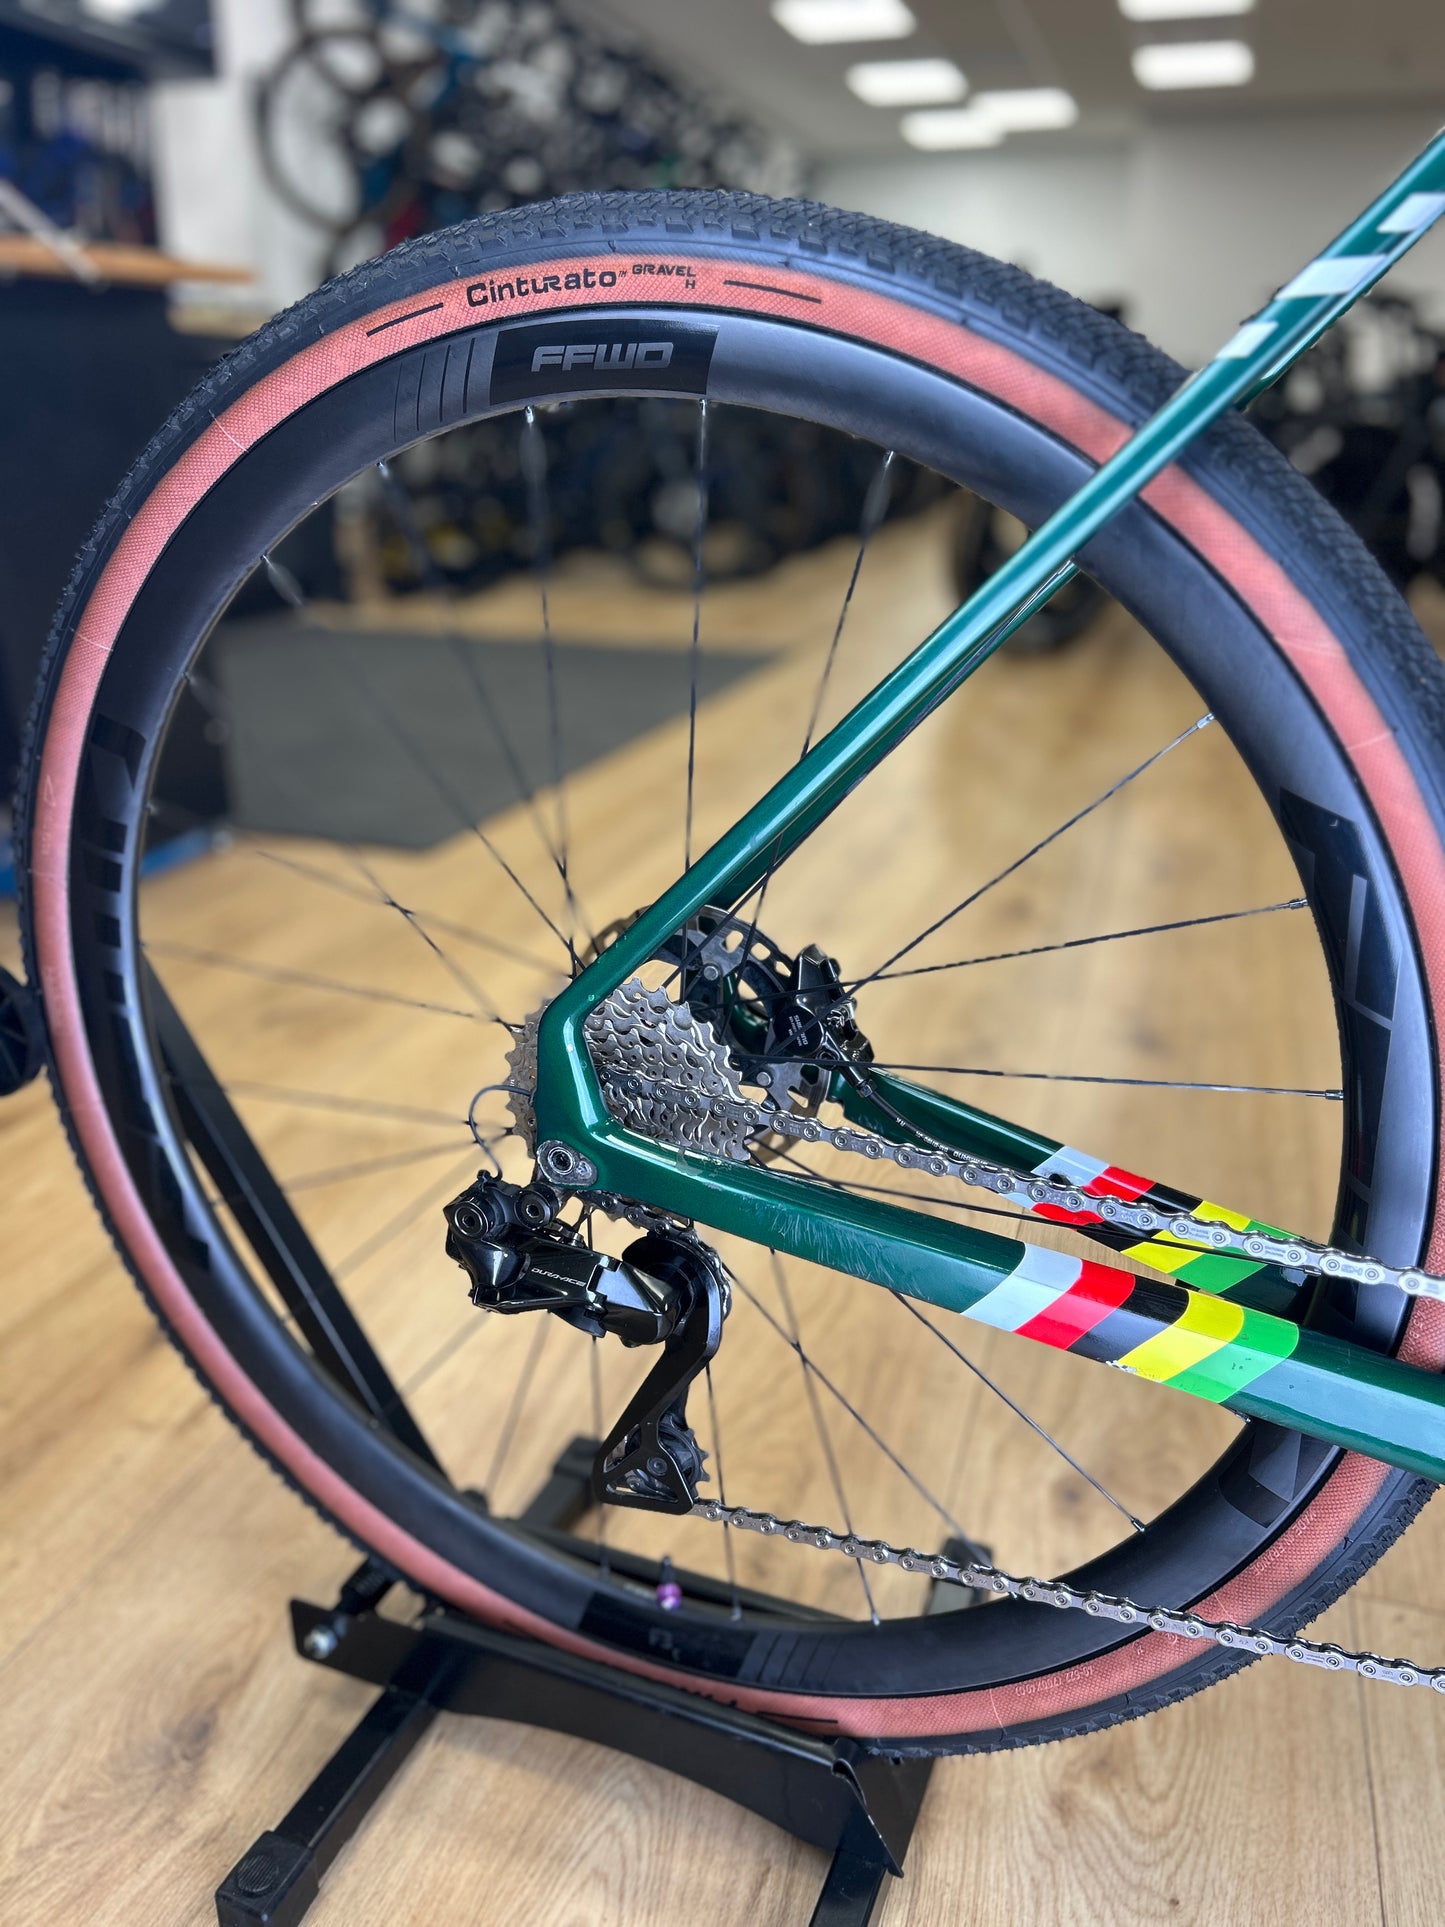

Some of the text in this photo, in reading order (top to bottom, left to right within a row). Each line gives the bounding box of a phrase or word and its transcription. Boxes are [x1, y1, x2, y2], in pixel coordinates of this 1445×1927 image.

[632, 263, 697, 278] GRAVEL
[684, 279, 696, 289] H
[531, 342, 674, 373] FFWD
[531, 1267, 587, 1287] DURA-ACE
[1292, 1508, 1317, 1536] MADE
